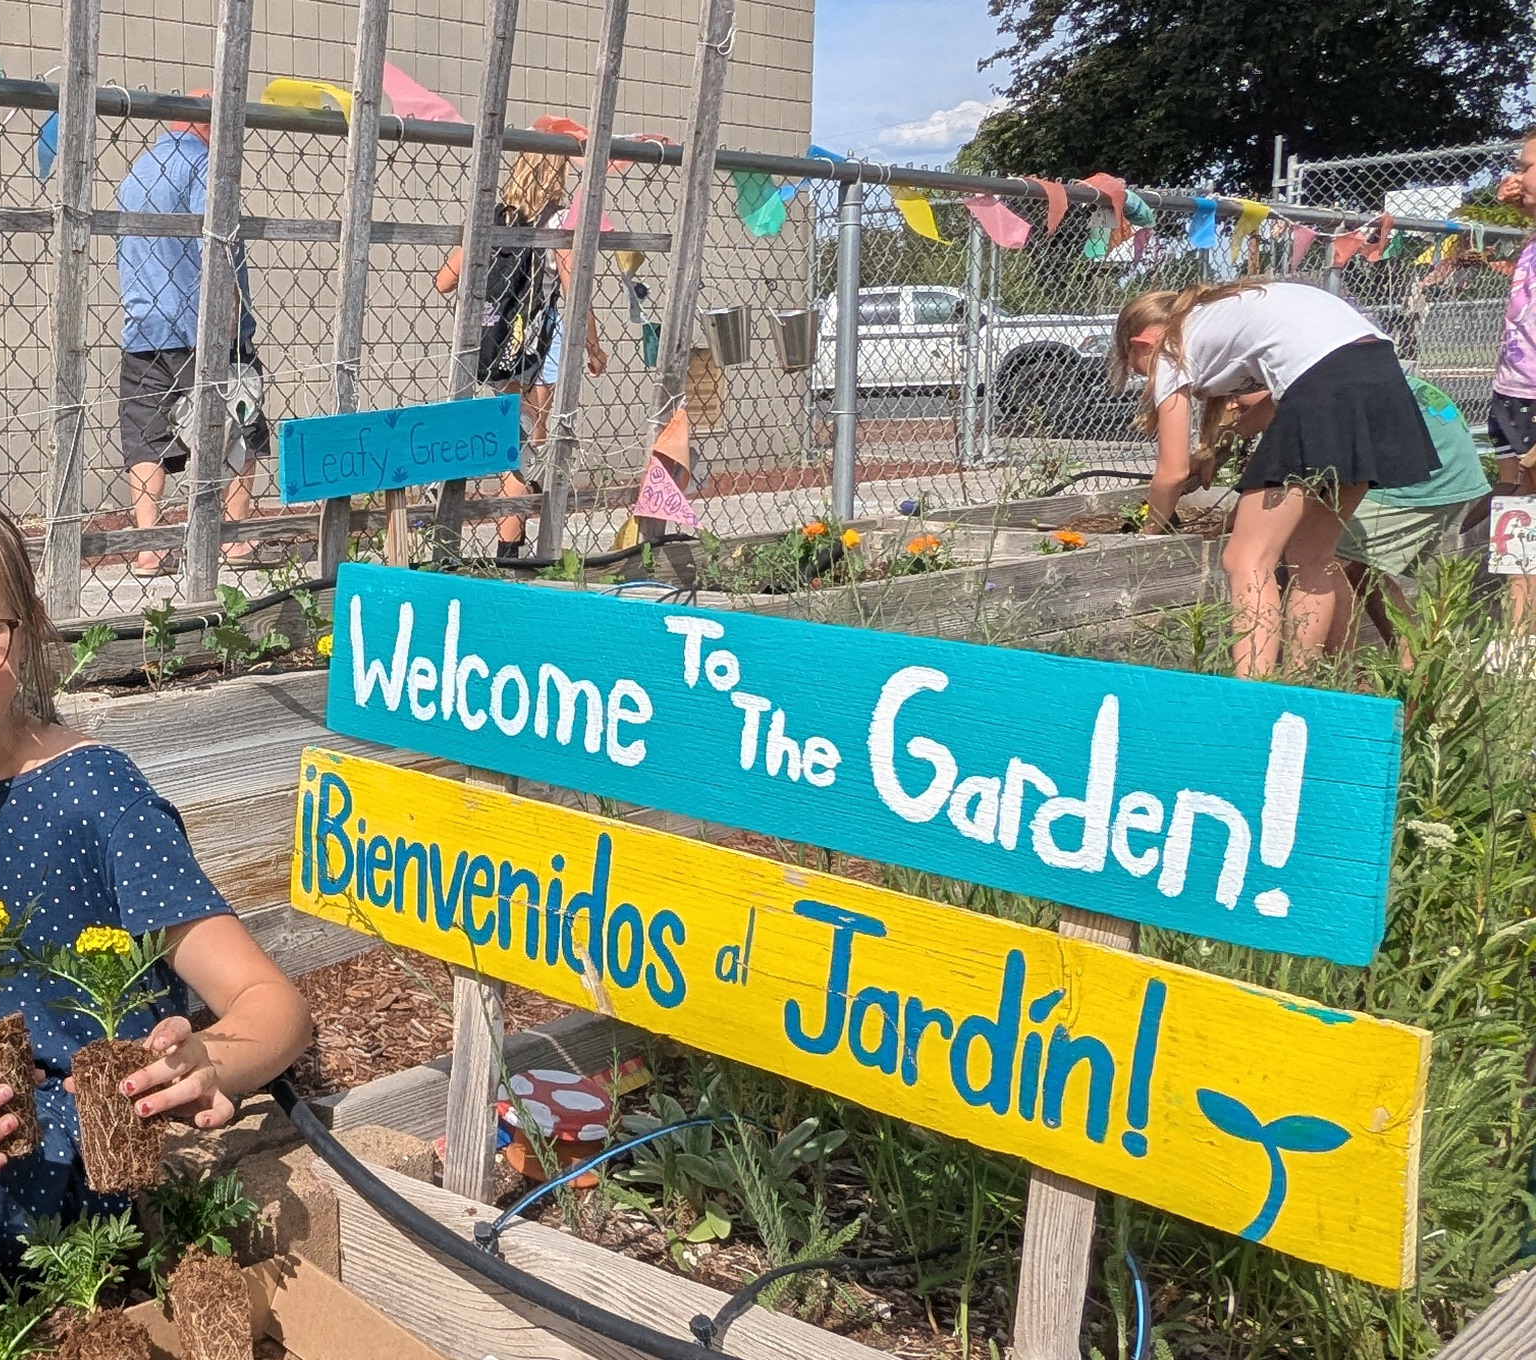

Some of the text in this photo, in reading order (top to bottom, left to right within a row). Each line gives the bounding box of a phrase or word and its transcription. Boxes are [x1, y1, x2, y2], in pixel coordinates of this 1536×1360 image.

[298, 421, 500, 490] Leafy Greens
[348, 593, 1309, 919] Welcome To The Garden!
[300, 763, 1168, 1159] ¡Bienvenidos al Jardín!
